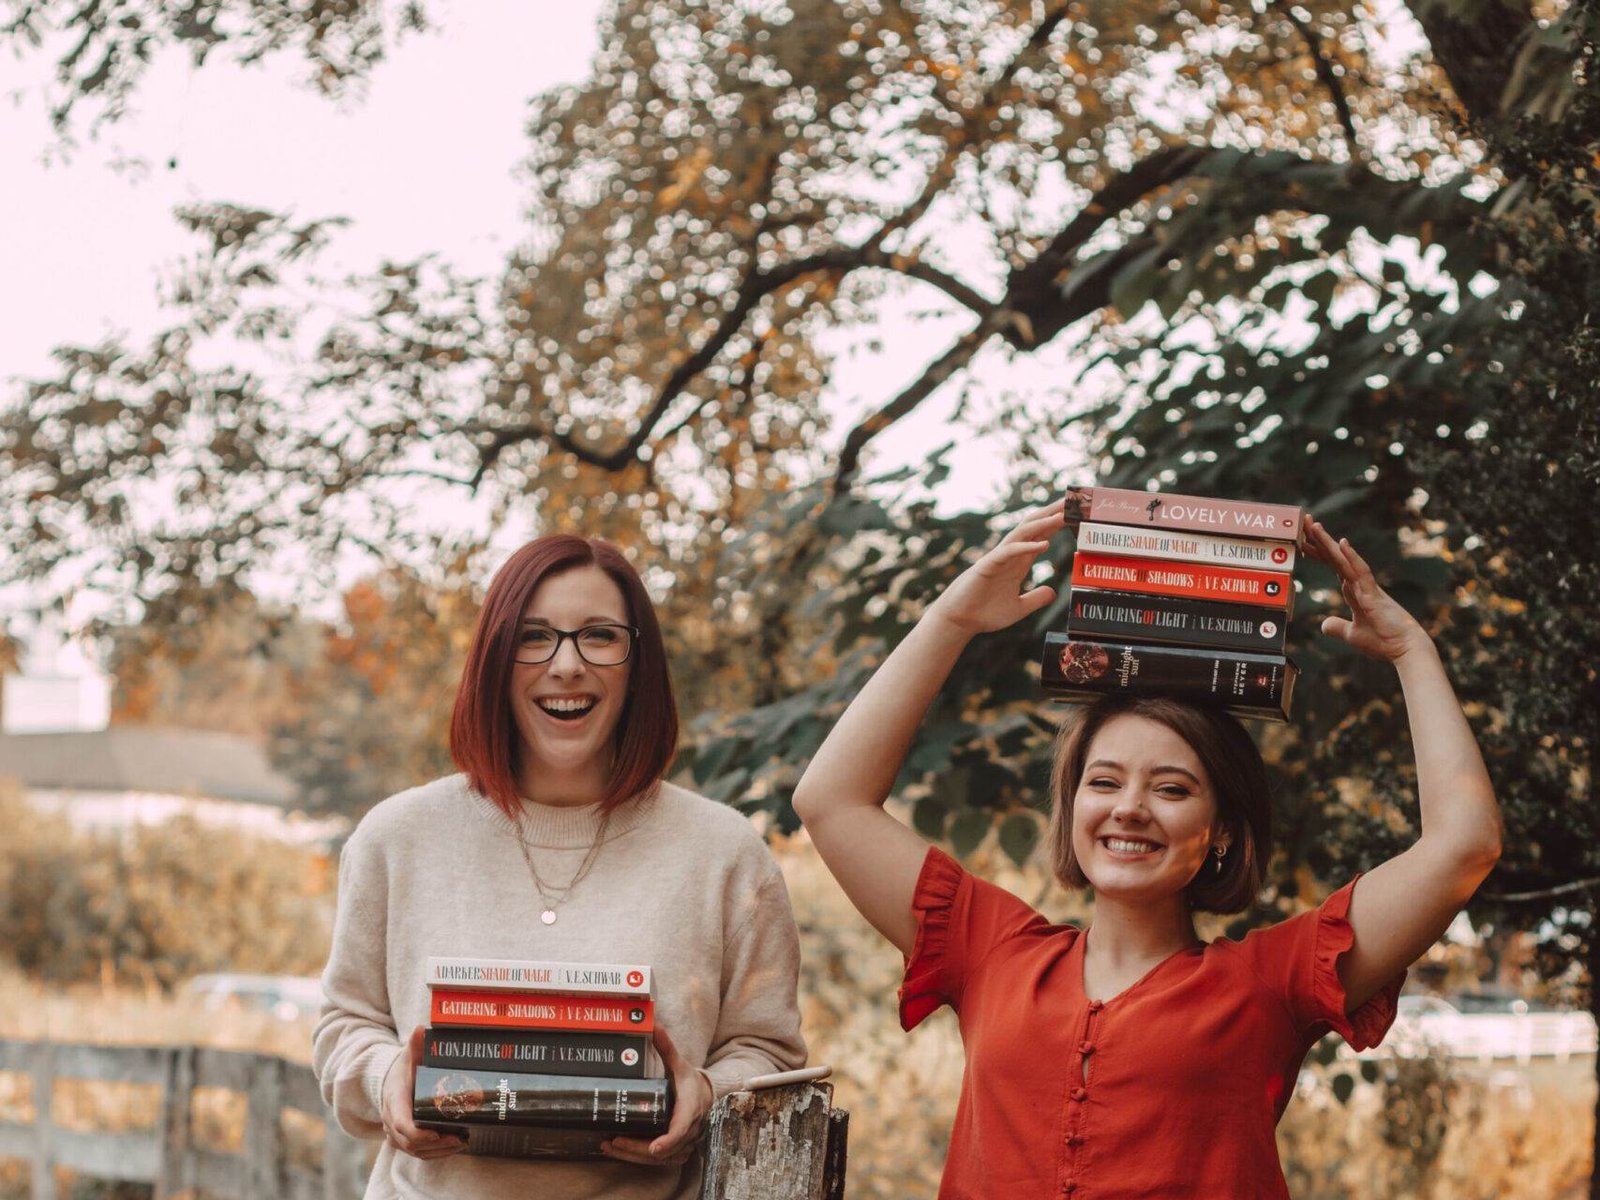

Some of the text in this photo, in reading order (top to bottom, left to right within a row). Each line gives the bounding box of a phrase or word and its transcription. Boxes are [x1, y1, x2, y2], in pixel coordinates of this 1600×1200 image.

[1161, 505, 1276, 529] LOVELY WAR
[1116, 646, 1134, 687] midnight
[1130, 659, 1140, 676] sun
[1239, 662, 1248, 695] MEYER
[492, 1078, 511, 1120] midnight
[508, 1090, 517, 1110] sun
[620, 1088, 628, 1123] MEYER
